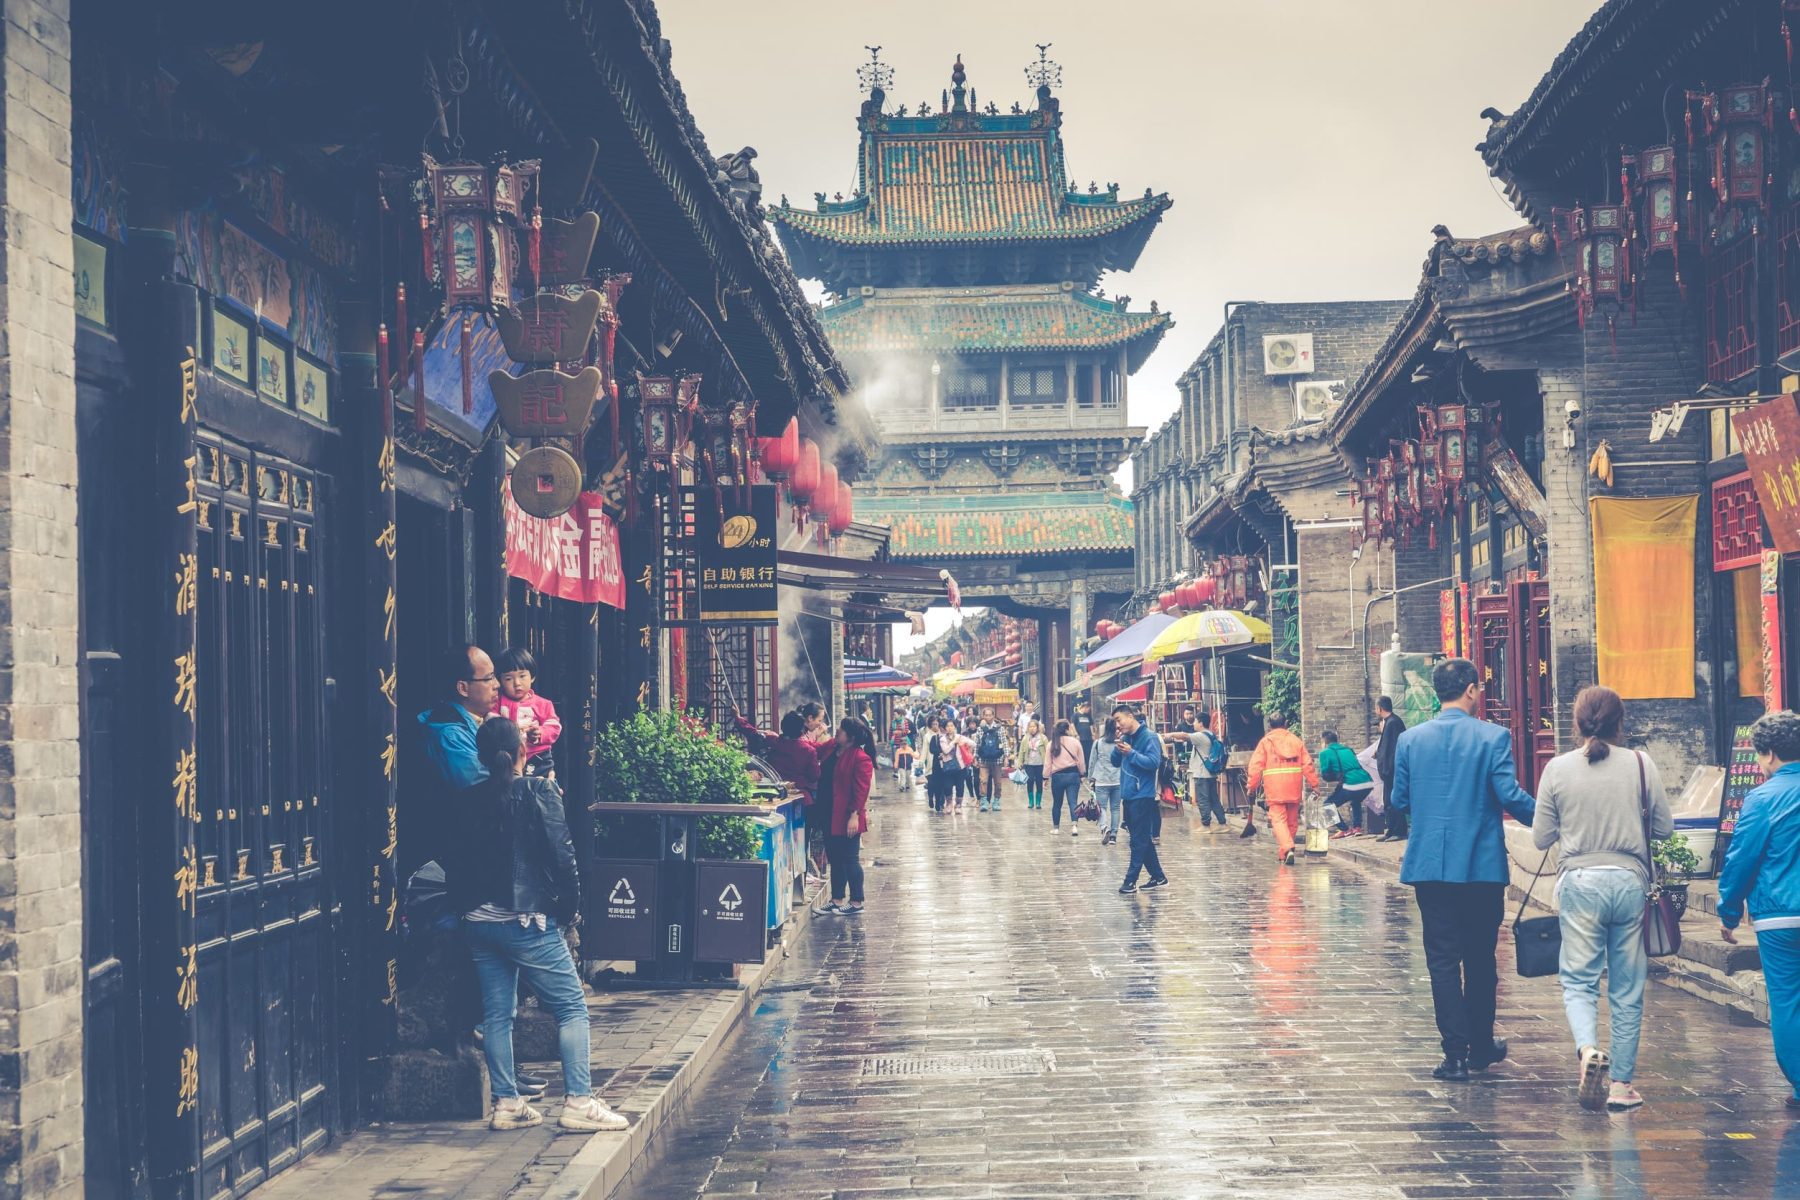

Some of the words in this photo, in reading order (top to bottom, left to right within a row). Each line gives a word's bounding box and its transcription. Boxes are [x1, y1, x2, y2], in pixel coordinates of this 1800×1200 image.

[749, 538, 771, 549] 小时
[703, 567, 775, 582] 自助银行
[608, 907, 636, 915] 可回收垃圾
